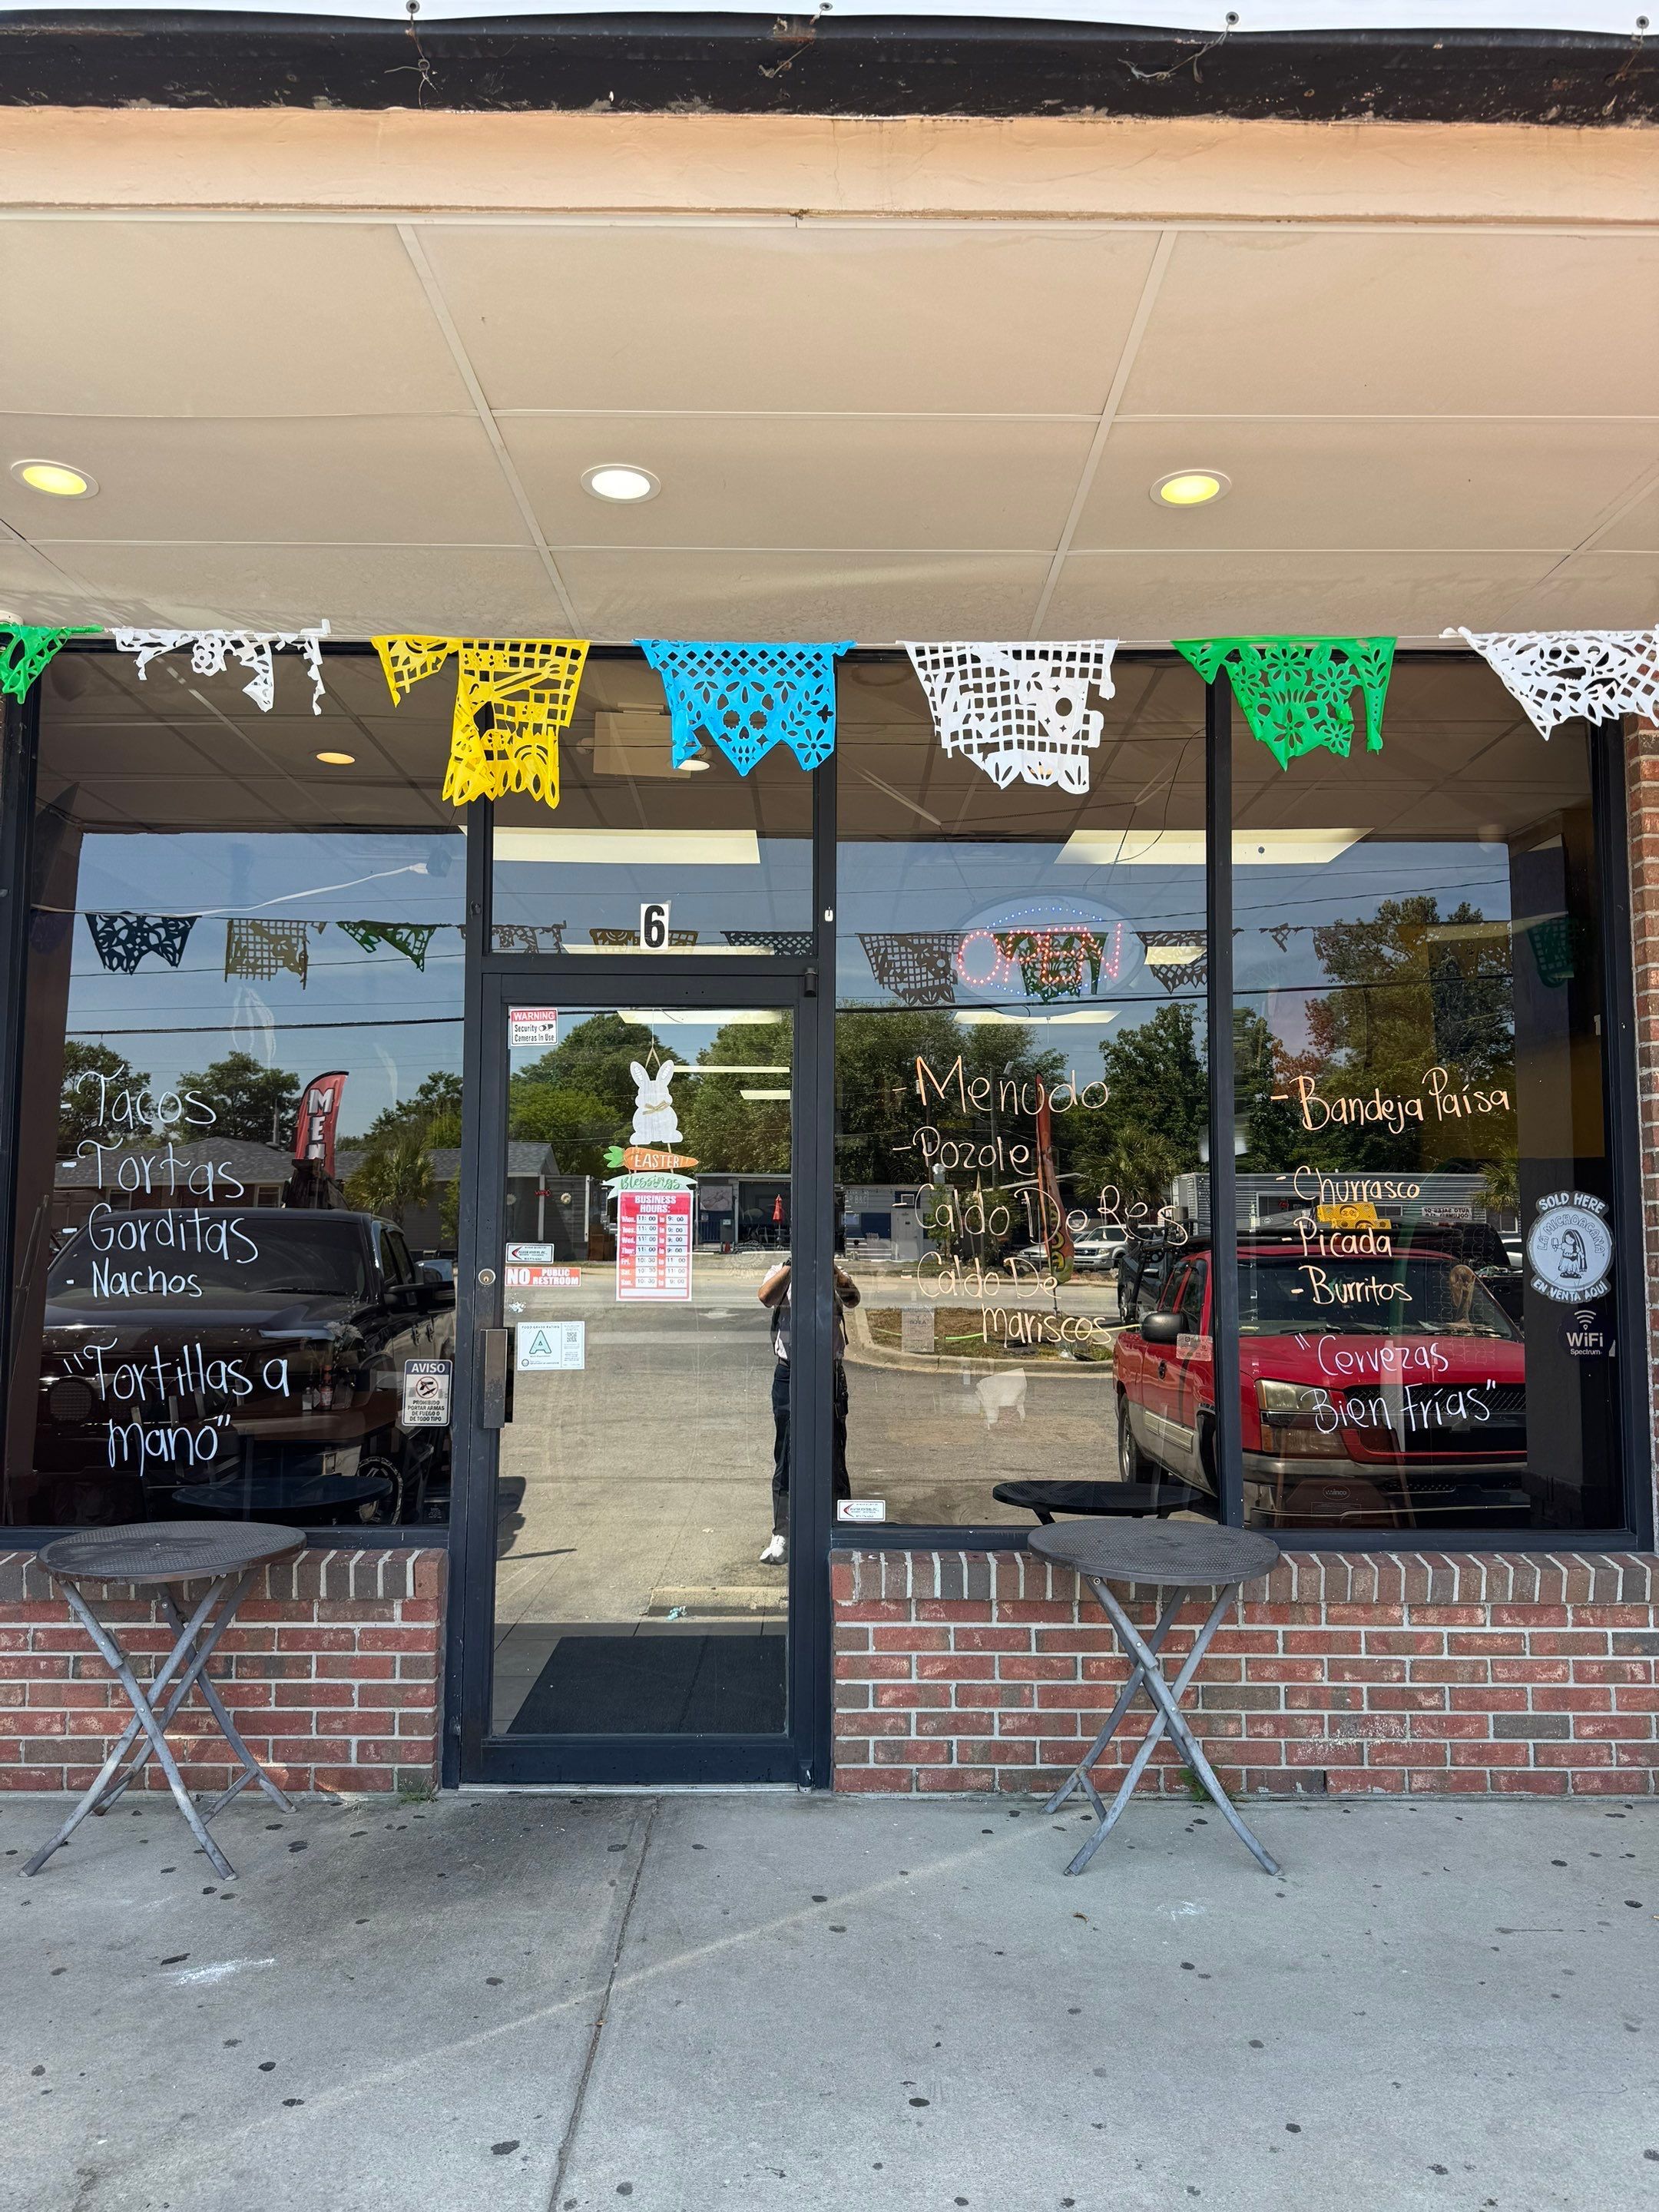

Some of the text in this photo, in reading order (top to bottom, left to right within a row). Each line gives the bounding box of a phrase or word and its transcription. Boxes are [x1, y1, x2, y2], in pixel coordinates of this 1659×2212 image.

[644, 905, 664, 948] 6
[957, 922, 1122, 984] OPEN
[514, 1011, 555, 1021] WARNING
[514, 1024, 538, 1033] Security
[514, 1034, 538, 1042] Cameras
[634, 1153, 680, 1168] EASTER
[634, 1195, 677, 1204] BUSINESS
[1538, 1192, 1606, 1214] SOLD HERE
[640, 1204, 671, 1213] HOURS:
[1097, 1184, 1189, 1246] Res
[1537, 1214, 1606, 1253] LA MICHOACANA
[507, 1268, 531, 1284] NO
[532, 1277, 578, 1285] RESTROOM
[1003, 1257, 1061, 1299] De
[1533, 1278, 1548, 1293] EN
[1550, 1287, 1581, 1302] VENTA
[528, 1330, 552, 1354] A
[1566, 1332, 1604, 1347] WiFi
[1570, 1348, 1601, 1356] Spectrum
[411, 1363, 445, 1373] AVISO
[263, 1358, 290, 1397] a
[1300, 1388, 1393, 1434] Bien
